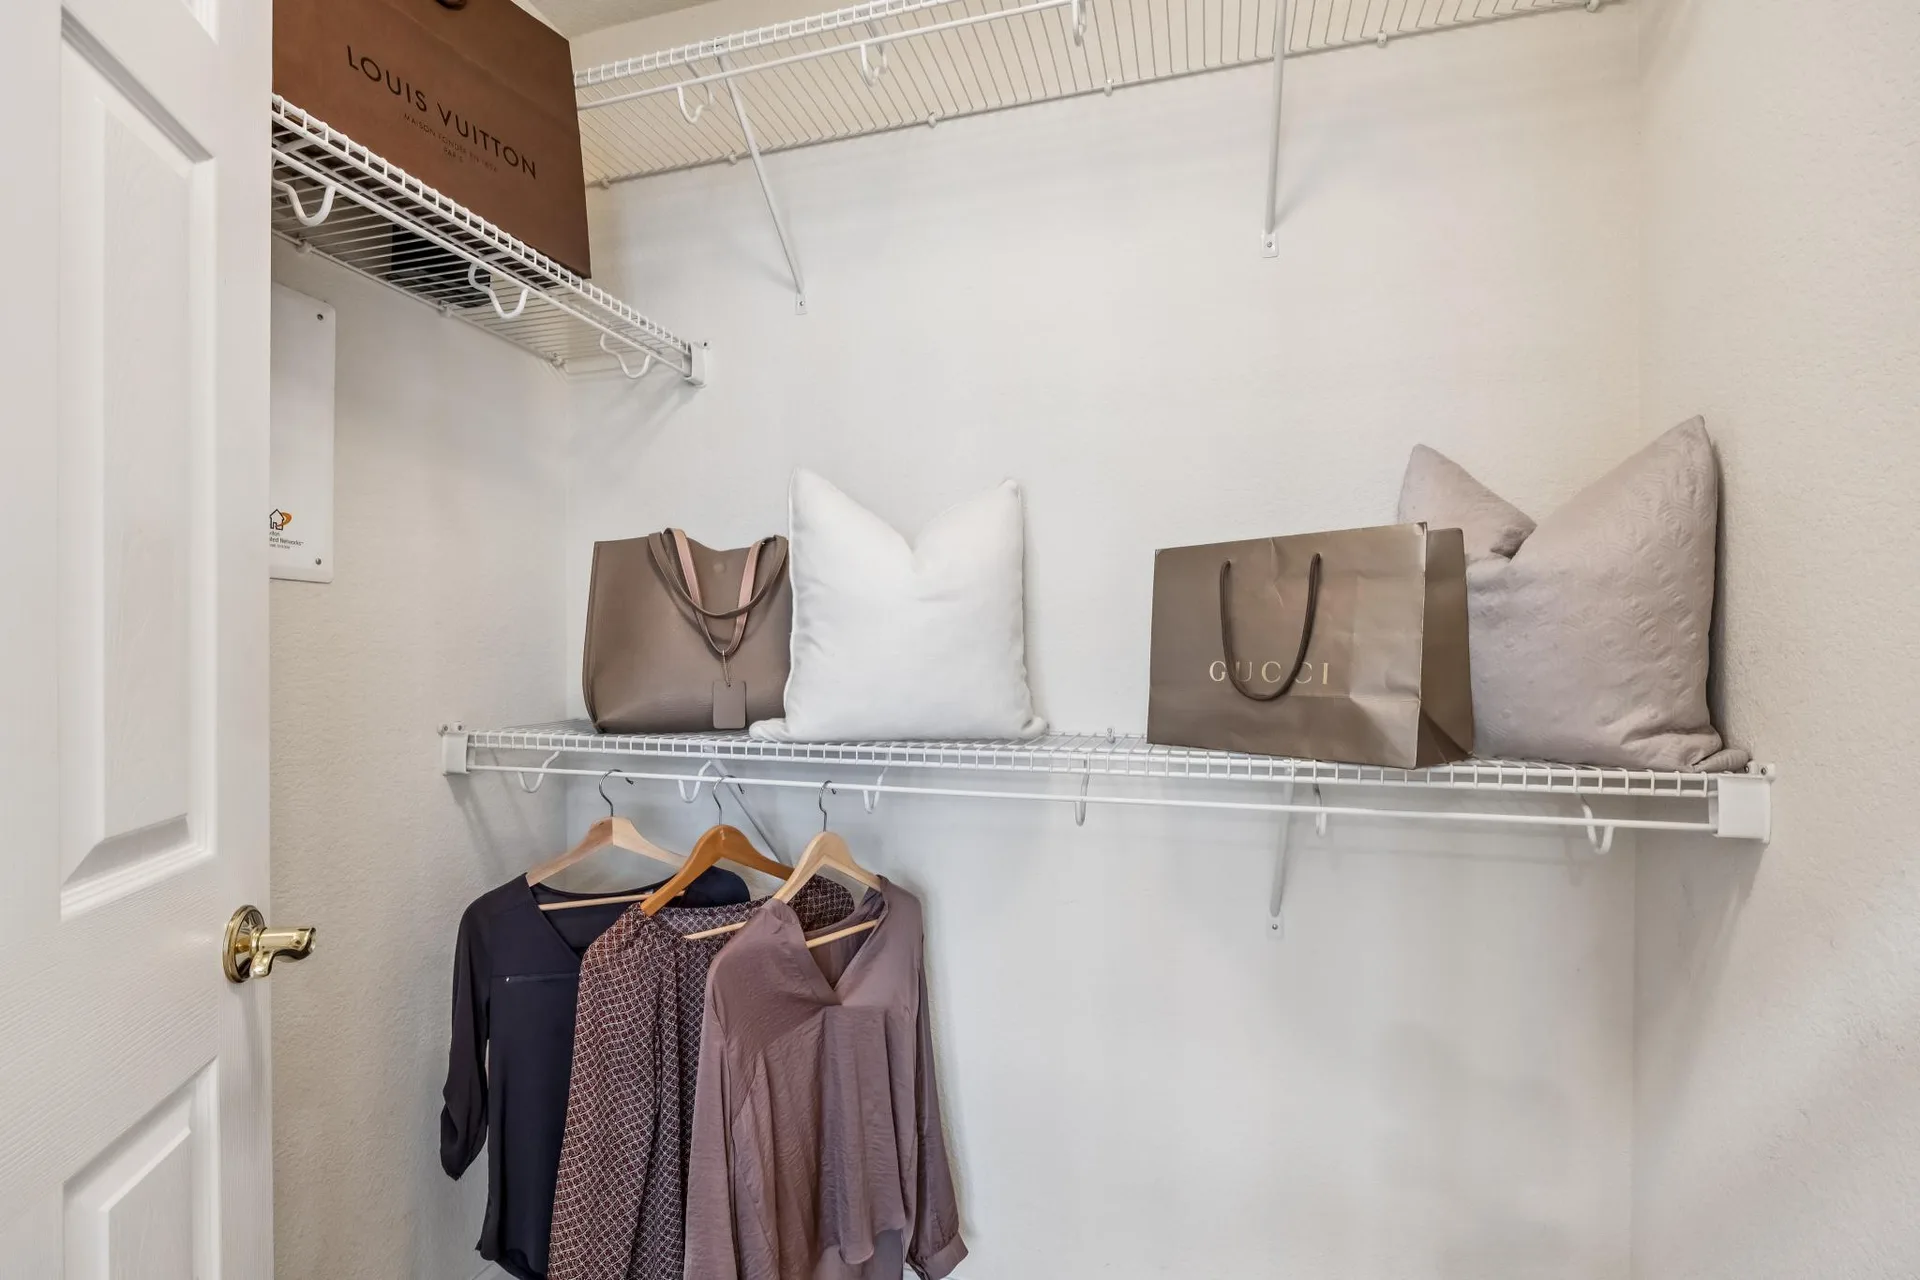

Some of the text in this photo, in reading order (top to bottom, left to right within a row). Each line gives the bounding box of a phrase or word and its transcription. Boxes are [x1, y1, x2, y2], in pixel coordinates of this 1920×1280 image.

[347, 45, 537, 180] LOUIS VUITTON
[404, 113, 436, 137] MAISON
[1209, 660, 1329, 685] GUCCI
